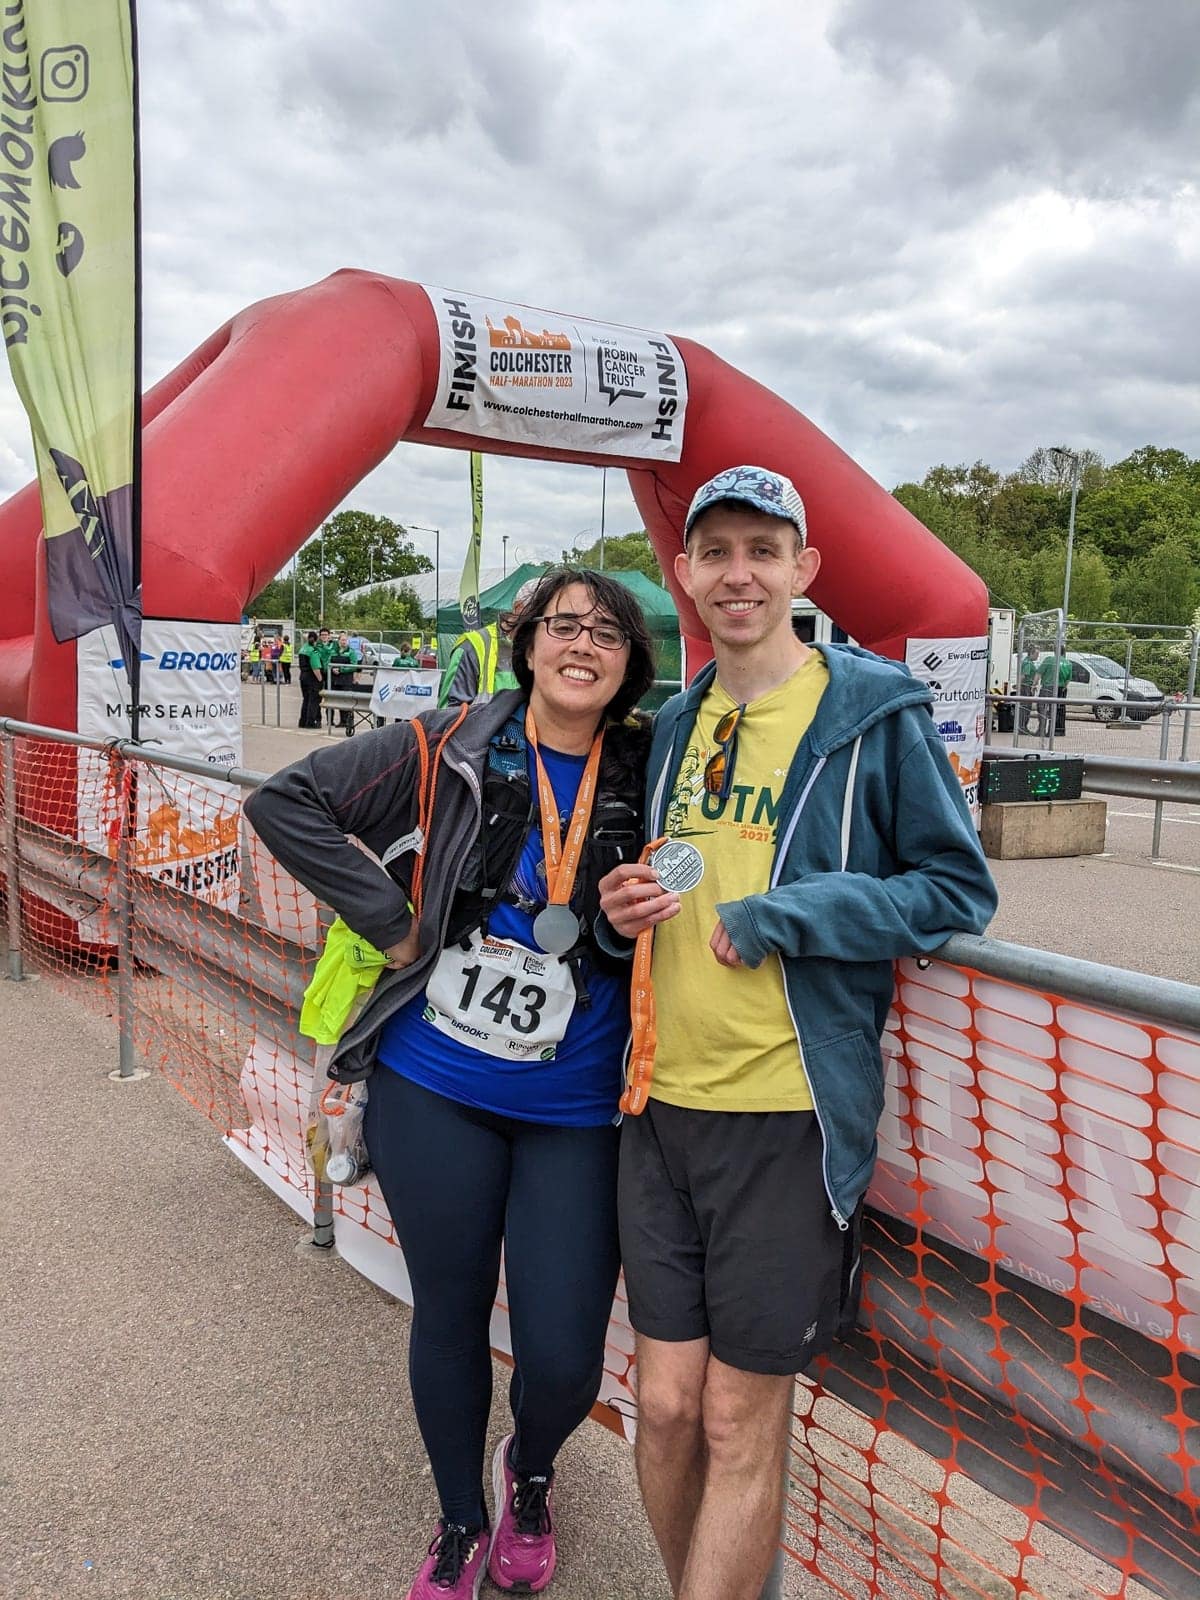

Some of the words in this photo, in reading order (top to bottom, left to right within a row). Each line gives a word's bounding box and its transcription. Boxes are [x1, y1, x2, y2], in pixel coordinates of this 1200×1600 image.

[442, 297, 477, 412] FINISH
[490, 351, 572, 373] COLCHESTER
[604, 347, 638, 363] ROBIN
[604, 359, 646, 377] CANCER
[490, 375, 553, 388] HALF-MARATHON
[555, 375, 573, 388] 2023
[605, 371, 635, 388] TRUST
[647, 339, 677, 442] FINISH
[482, 399, 644, 430] www.colchesterhalfmarathon.com
[159, 651, 238, 671] BROOKS
[738, 829, 770, 843] 2021
[666, 856, 695, 885] COLCHESTER
[479, 944, 514, 959] COLCHESTER
[458, 964, 547, 1034] 143
[450, 1018, 491, 1041] BROOKS
